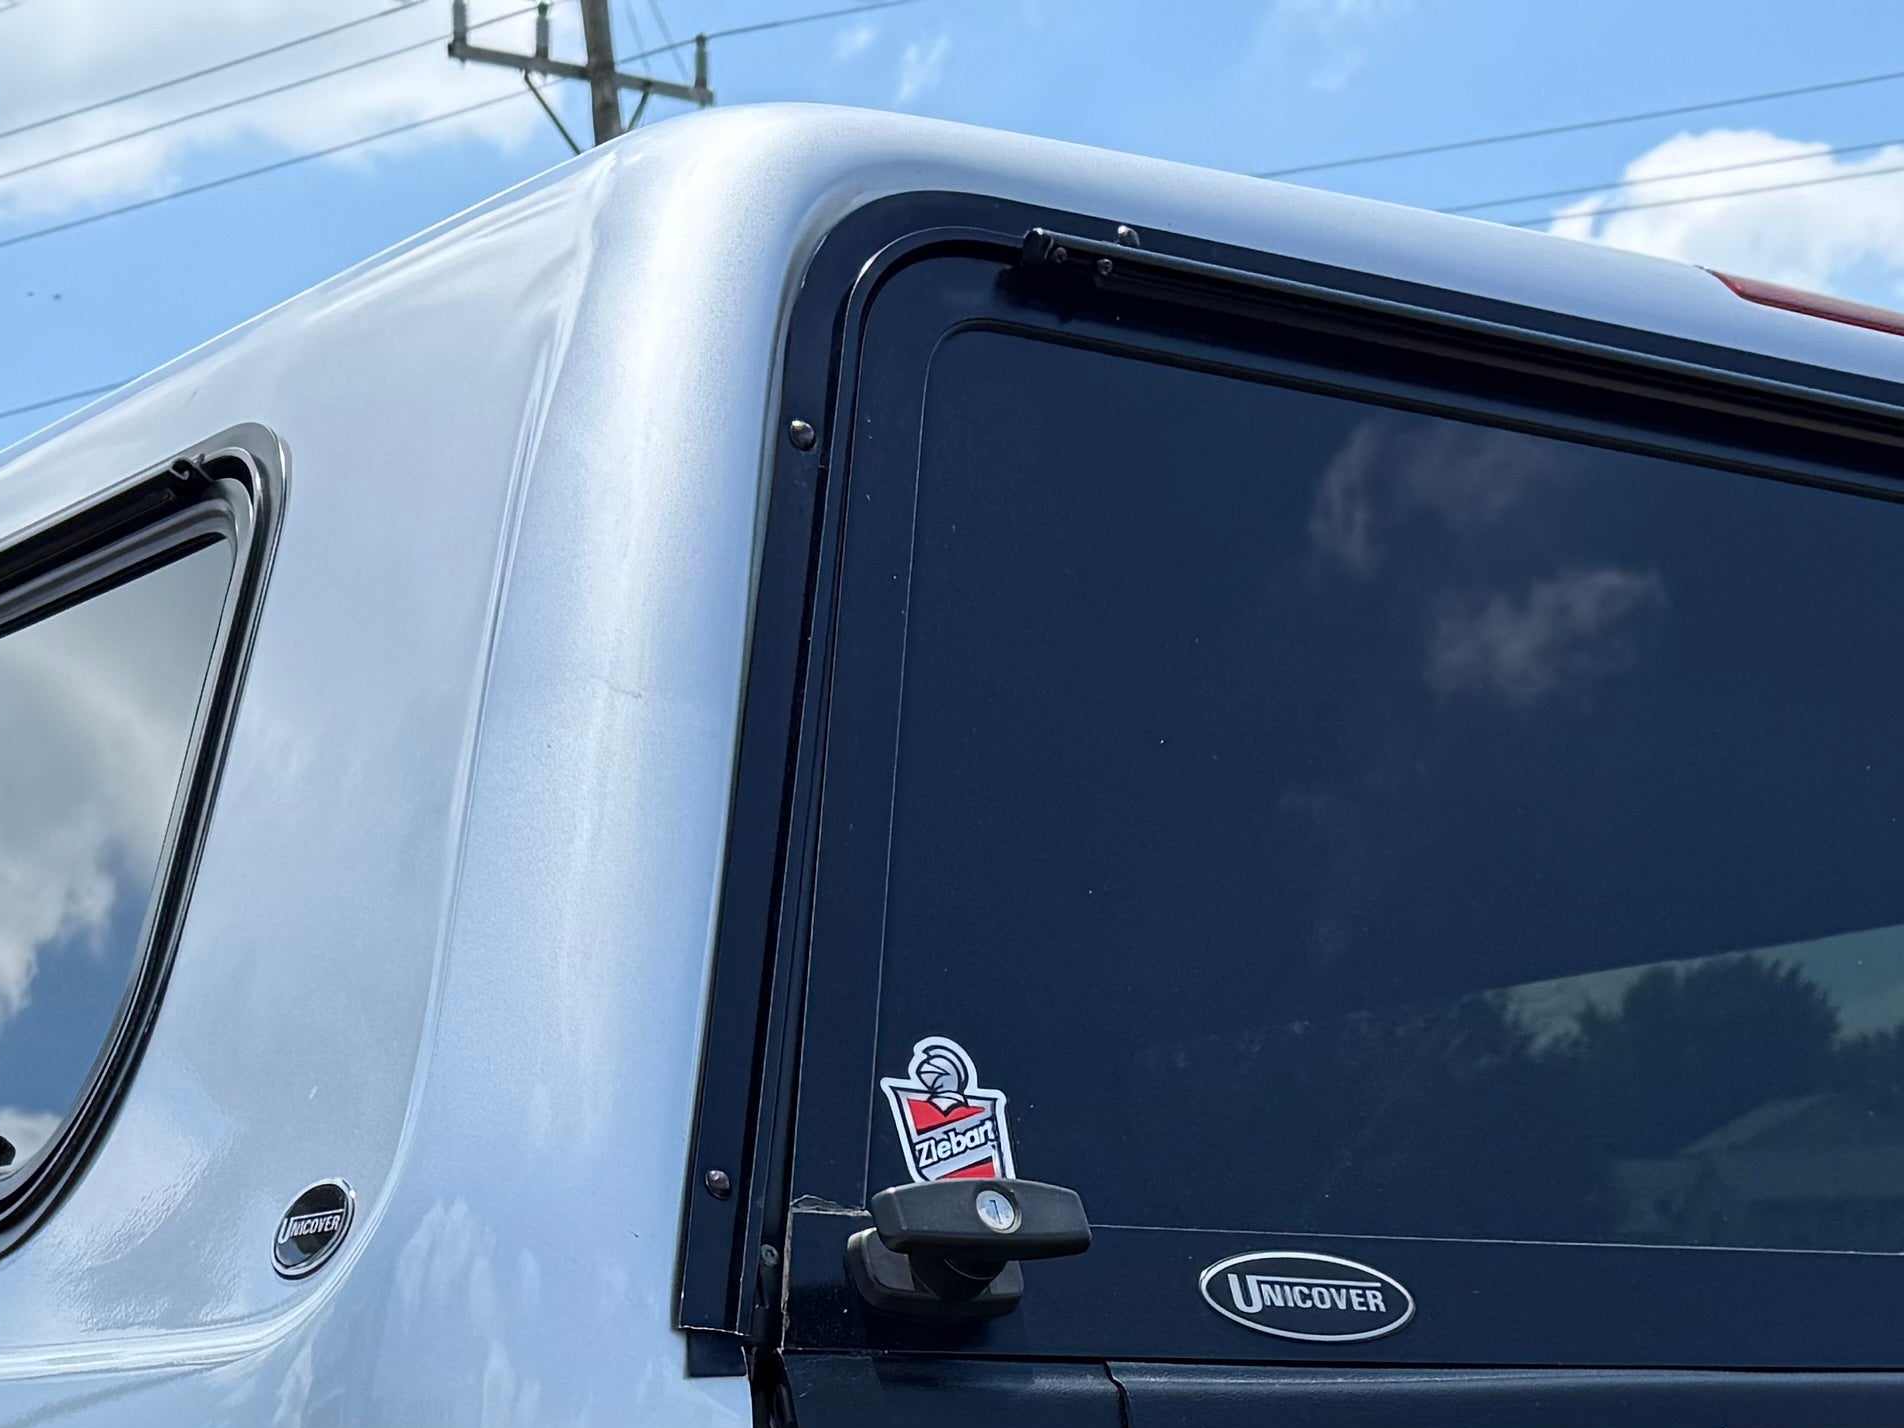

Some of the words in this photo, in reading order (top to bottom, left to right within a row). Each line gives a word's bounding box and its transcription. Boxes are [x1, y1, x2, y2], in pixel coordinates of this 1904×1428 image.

[915, 1119, 995, 1168] Ziebart
[277, 1209, 345, 1244] UNICOVER
[1227, 1273, 1387, 1314] UNICOVER
